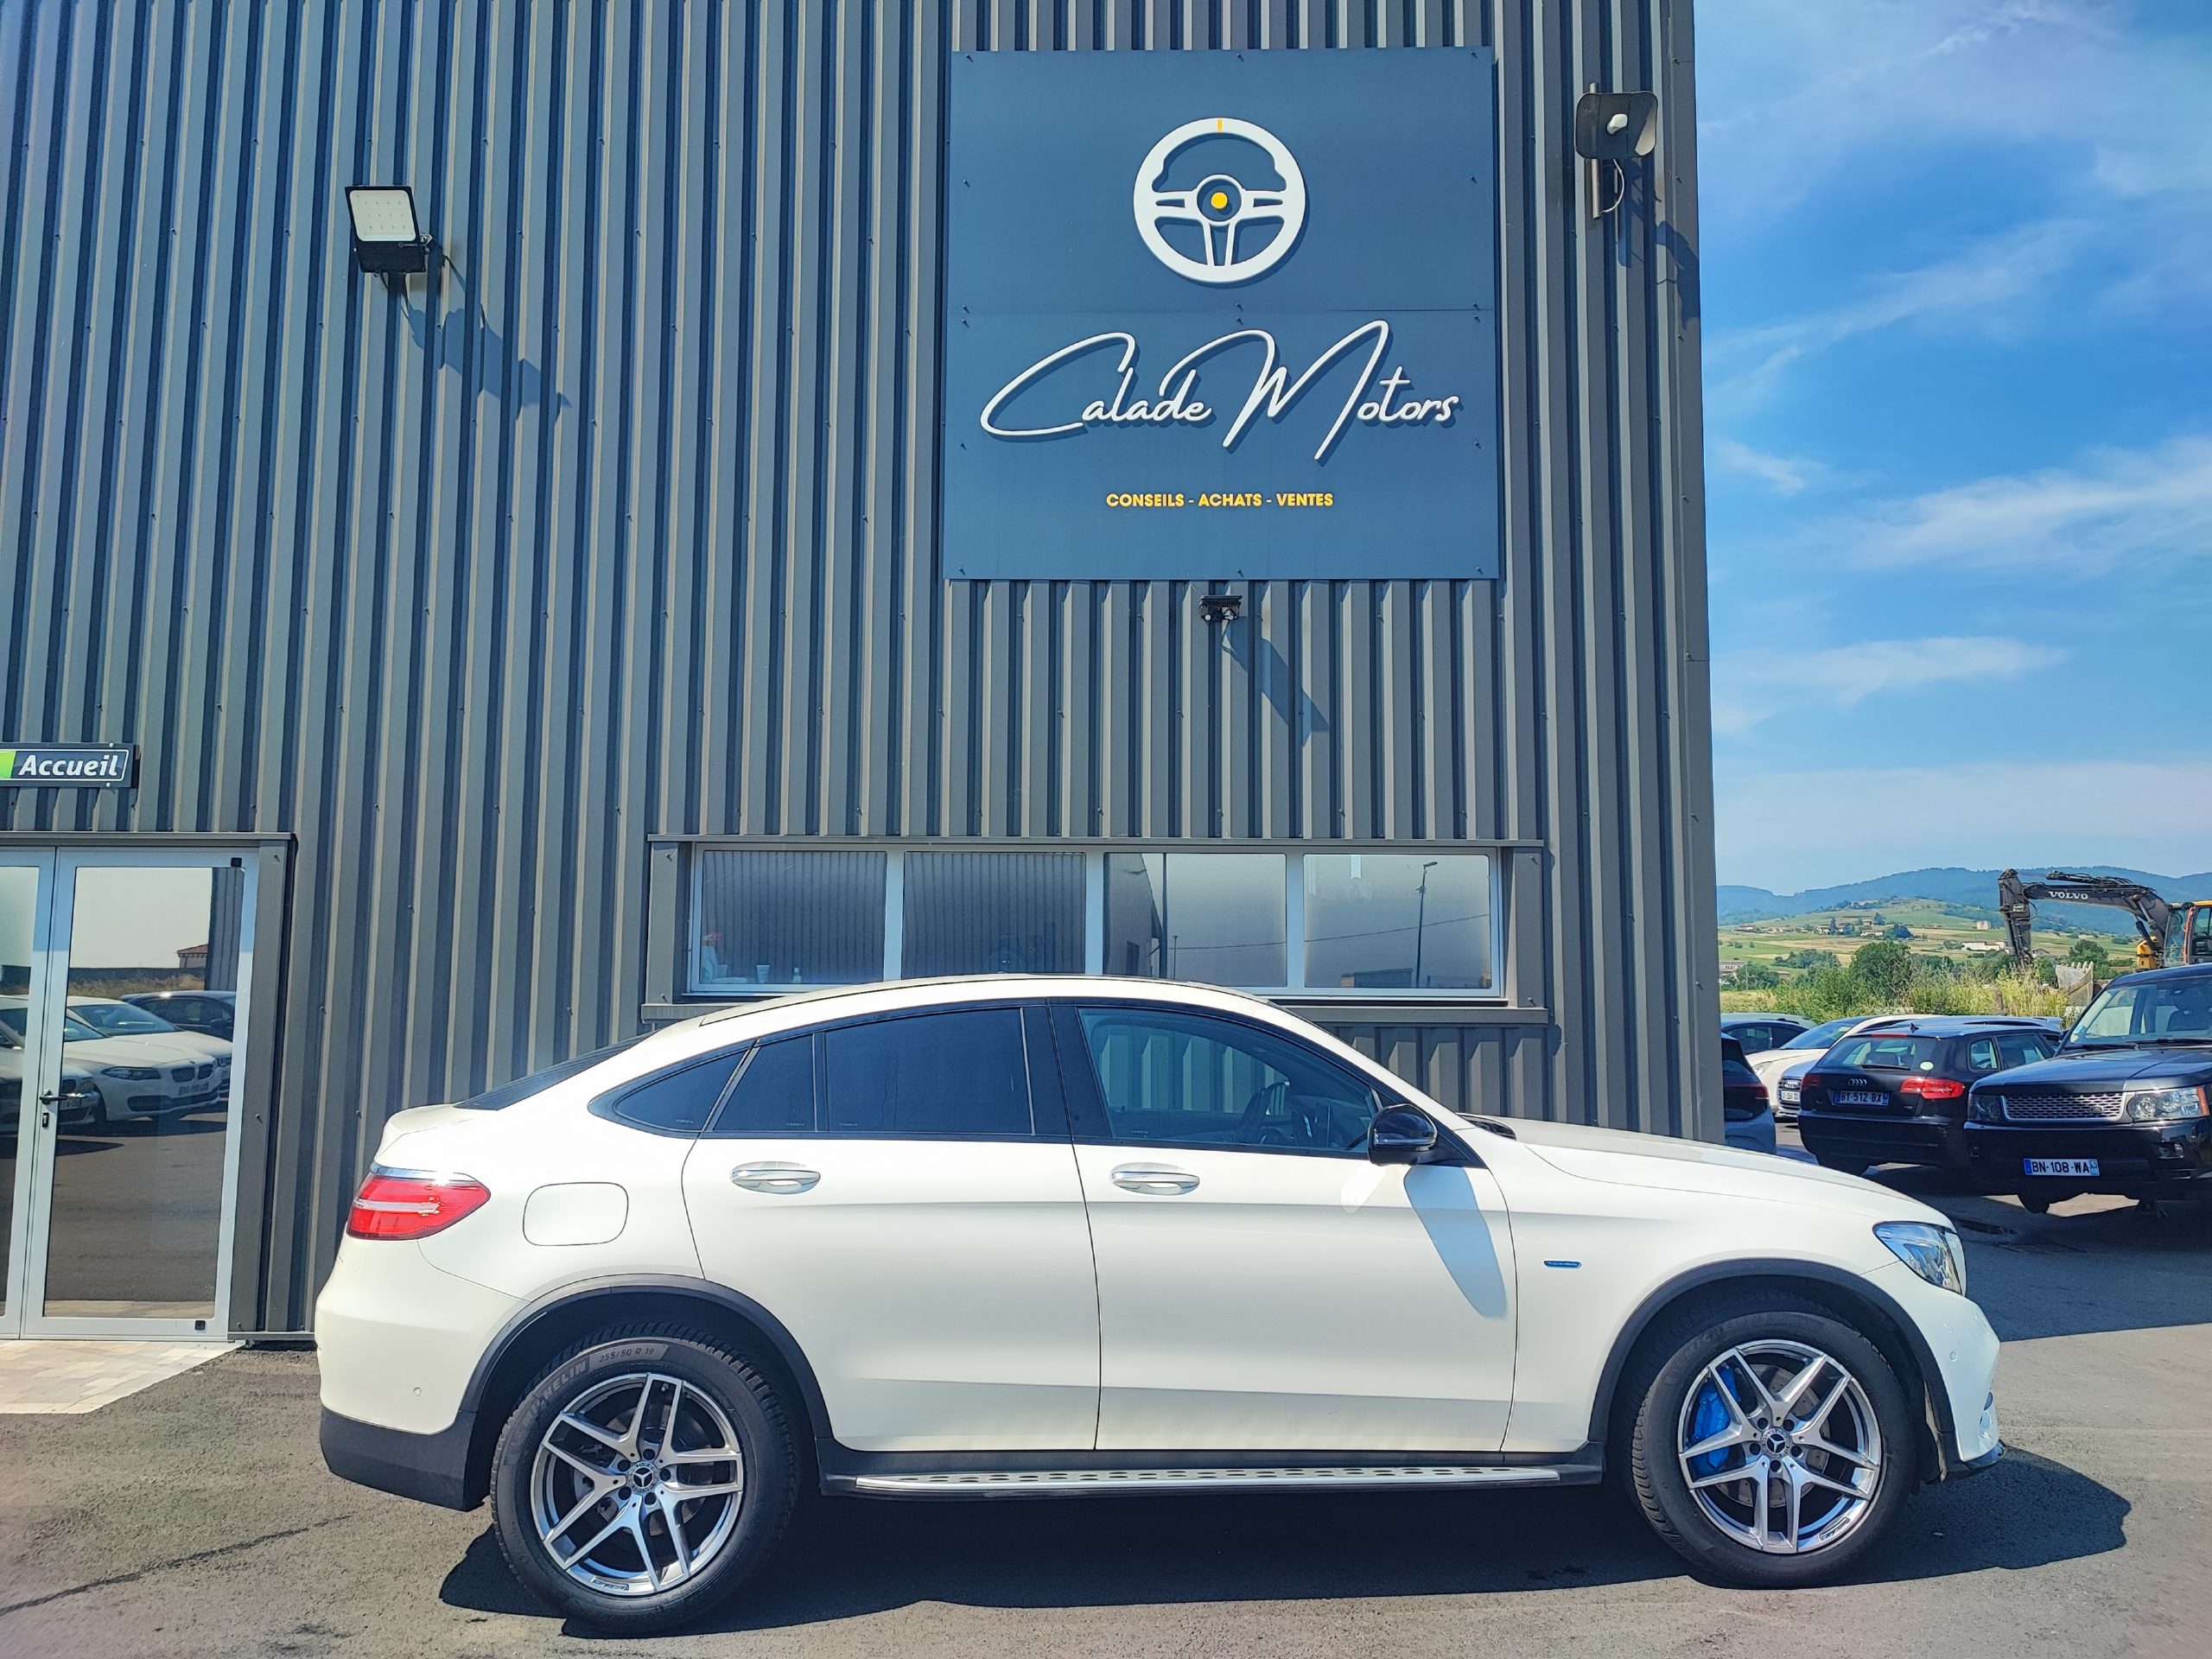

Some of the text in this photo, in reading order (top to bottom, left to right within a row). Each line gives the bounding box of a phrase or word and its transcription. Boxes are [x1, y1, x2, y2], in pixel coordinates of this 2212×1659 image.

[980, 320, 1459, 461] Calade Motors
[1105, 493, 1185, 508] CONSEILS
[1198, 493, 1264, 508] ACHATS
[1275, 493, 1335, 508] VENTES
[17, 754, 119, 777] Accueil
[2048, 891, 2089, 900] VOLVO
[1840, 1091, 1883, 1103] BY-512-BX
[2031, 1161, 2090, 1173] BN-108-WA
[599, 1350, 632, 1363] 255/50
[645, 1347, 655, 1356] 19
